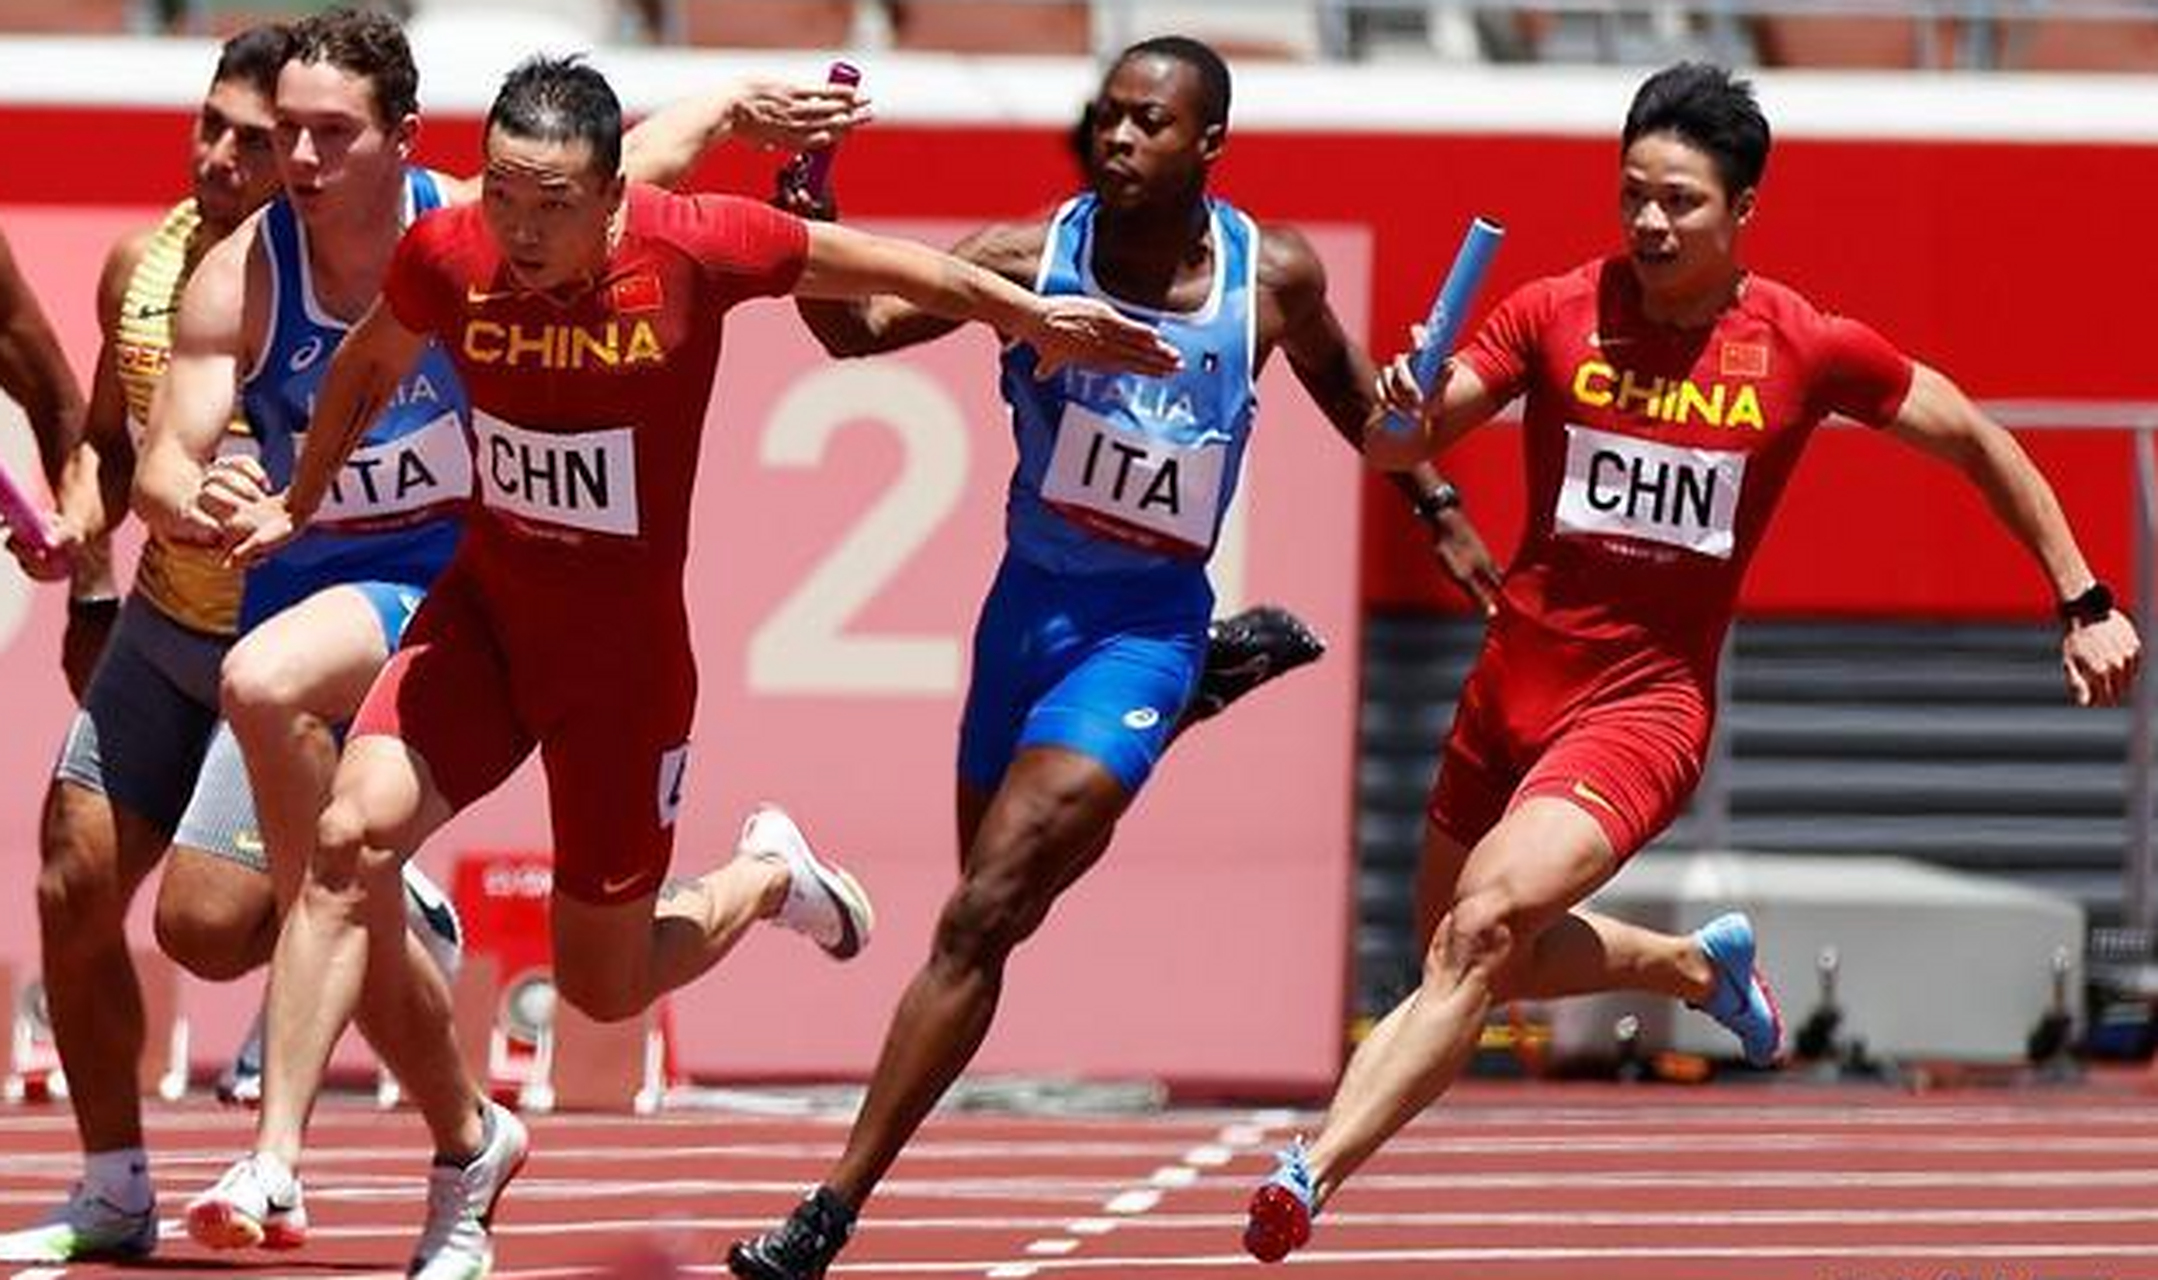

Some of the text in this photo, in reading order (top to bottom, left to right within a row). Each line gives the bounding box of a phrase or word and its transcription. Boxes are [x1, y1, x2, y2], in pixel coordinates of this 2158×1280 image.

[463, 319, 664, 369] CHINA
[1573, 359, 1765, 431] CHINA
[490, 433, 608, 509] CHN
[1081, 432, 1180, 516] ITA
[1587, 450, 1718, 529] CHN
